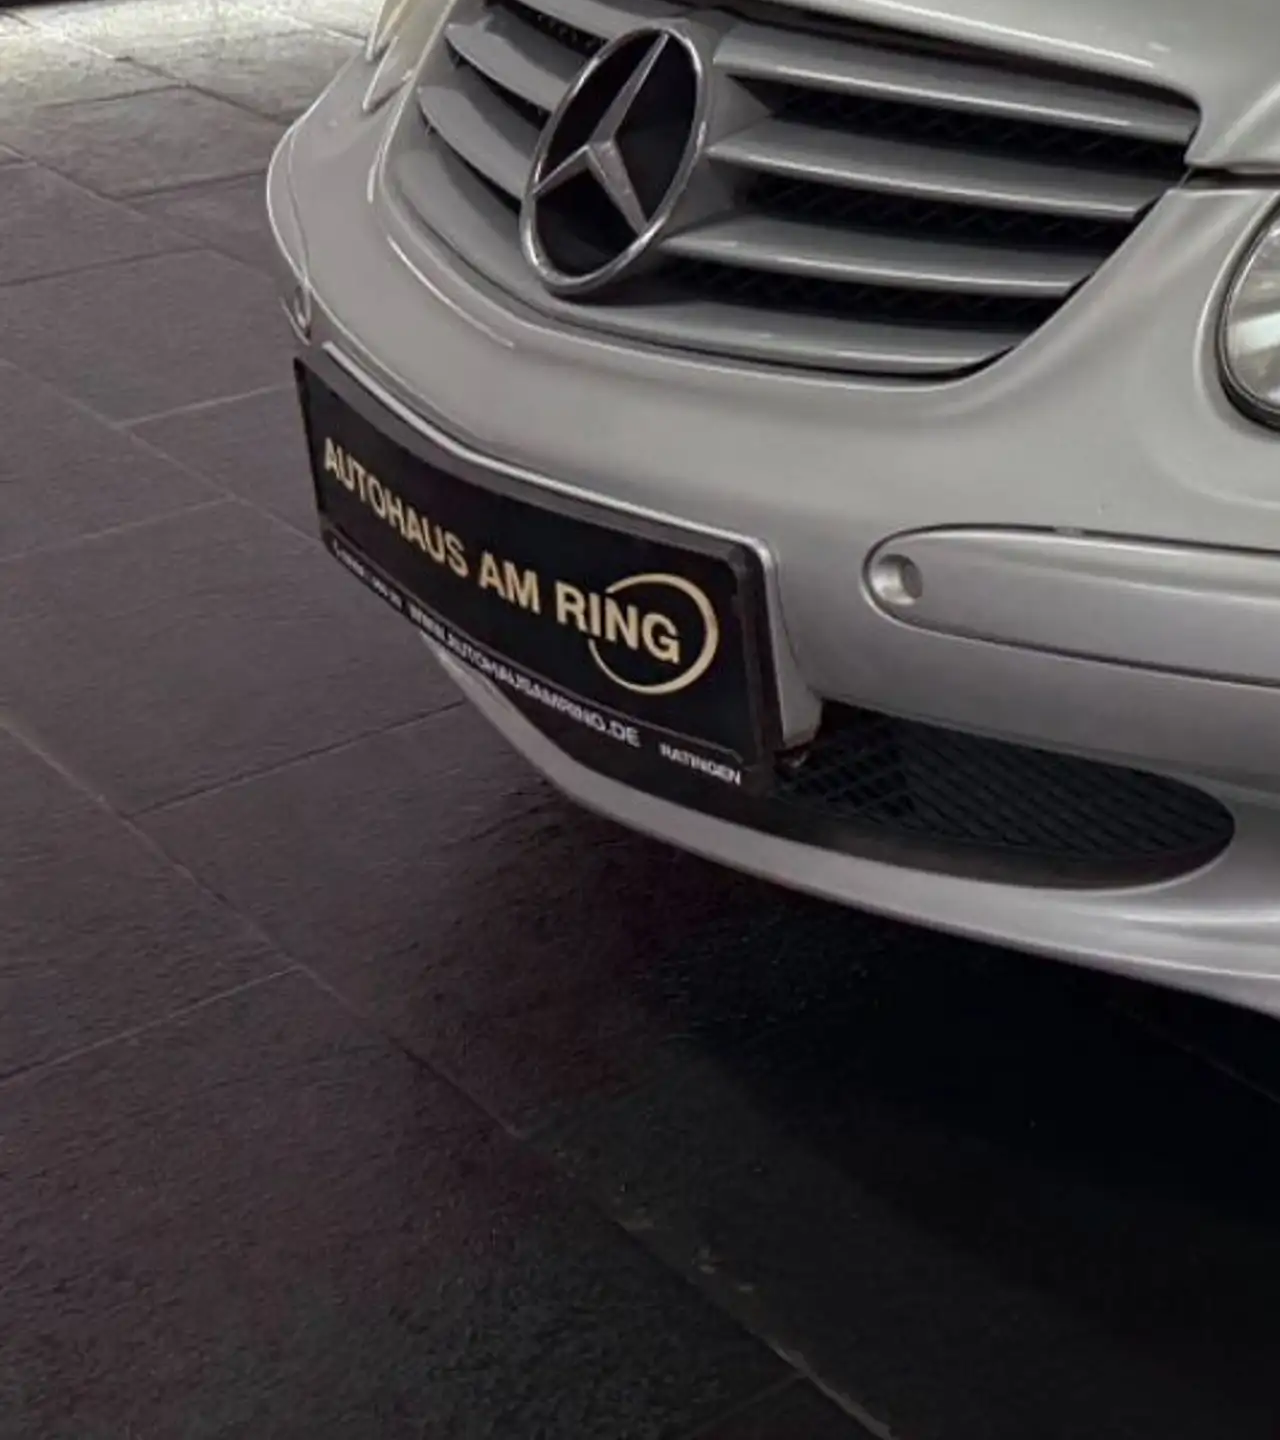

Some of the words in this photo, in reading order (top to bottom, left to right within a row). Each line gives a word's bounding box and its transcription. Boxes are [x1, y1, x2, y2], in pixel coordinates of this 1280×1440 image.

[323, 437, 469, 578] AUTOHAUS
[479, 551, 541, 614] AM
[555, 581, 681, 664] RING
